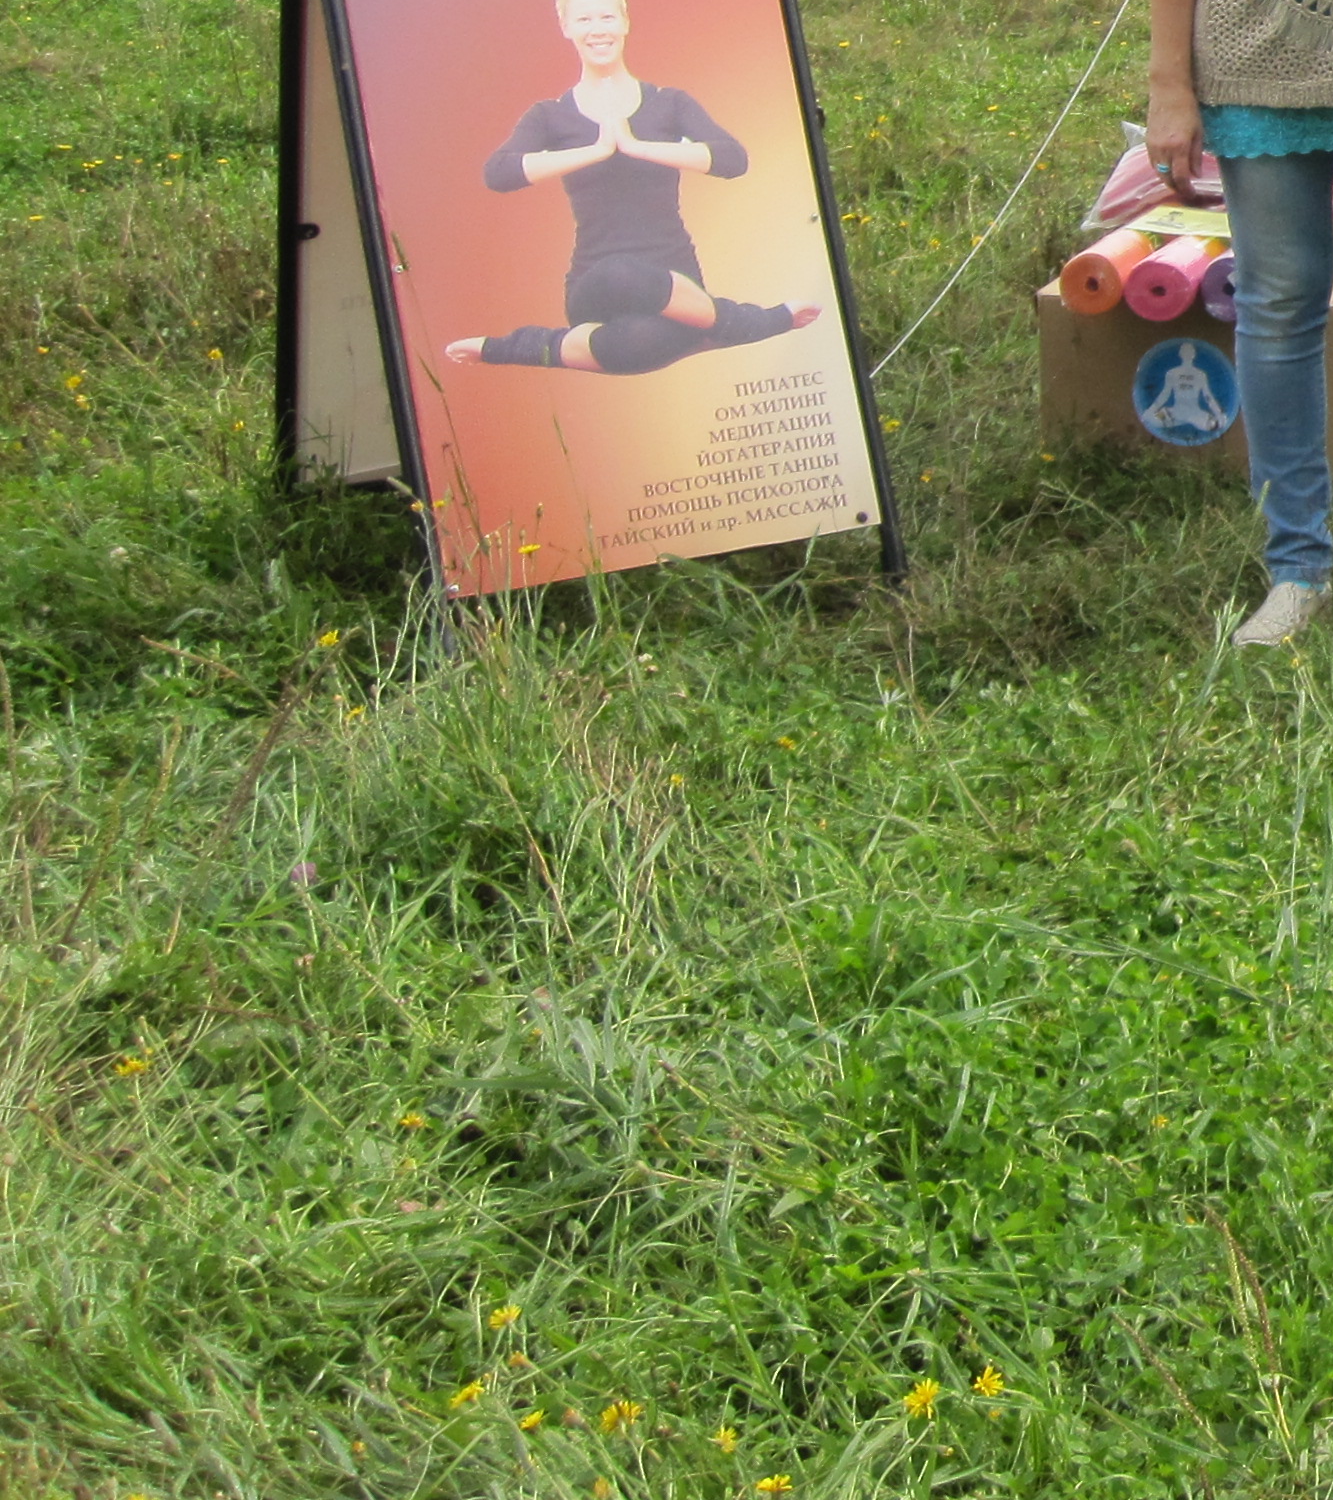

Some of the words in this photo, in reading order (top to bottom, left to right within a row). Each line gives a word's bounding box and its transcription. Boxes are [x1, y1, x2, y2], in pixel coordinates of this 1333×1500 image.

[735, 371, 825, 398] ПИЛАТЕС
[714, 405, 746, 422] ОМ
[751, 392, 827, 417] ХИЛИНГ
[709, 412, 832, 444] МЕДИТАЦИИ
[696, 432, 836, 468] ЙОГАТЕРАПИЯ
[643, 465, 765, 498] ВОСТОЧНЫЕ
[769, 452, 840, 477] ТАНЦЫ
[628, 494, 722, 523] ПОМОЩЬ
[727, 473, 844, 506] ПСИХОЛОГА
[597, 518, 696, 550] ТАЙСКИЙ
[700, 520, 712, 532] и
[746, 493, 848, 524] МАССАЖИ
